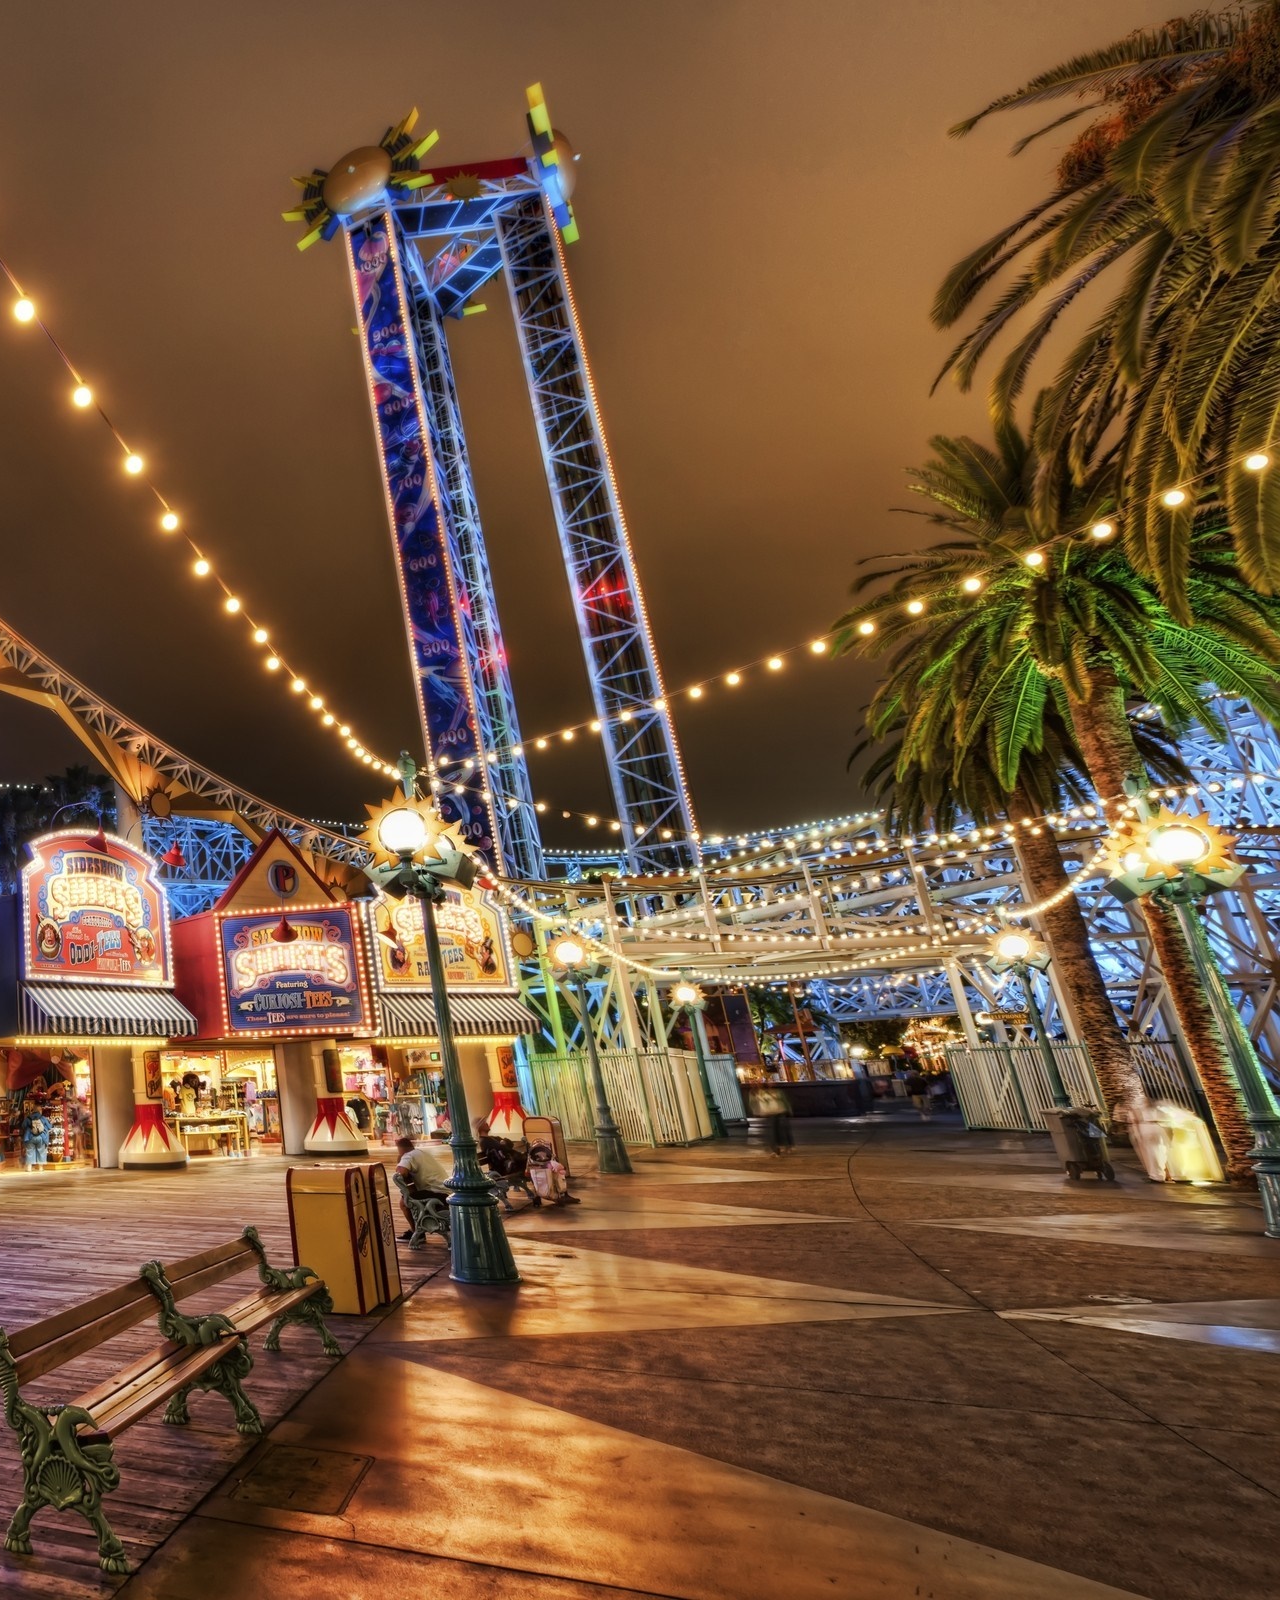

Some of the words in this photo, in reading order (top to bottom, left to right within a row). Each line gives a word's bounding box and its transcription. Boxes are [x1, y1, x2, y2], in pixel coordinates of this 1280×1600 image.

[373, 323, 398, 343] 900
[384, 399, 410, 415] 800
[398, 474, 423, 491] 700
[409, 553, 437, 571] 600
[422, 639, 451, 657] 500
[437, 727, 468, 745] 400
[460, 822, 483, 838] 00
[66, 856, 123, 881] SIDESHOW
[274, 864, 296, 893] P
[235, 944, 349, 991] SHIRTS
[275, 980, 309, 989] Featuring
[267, 1012, 286, 1024] TEES
